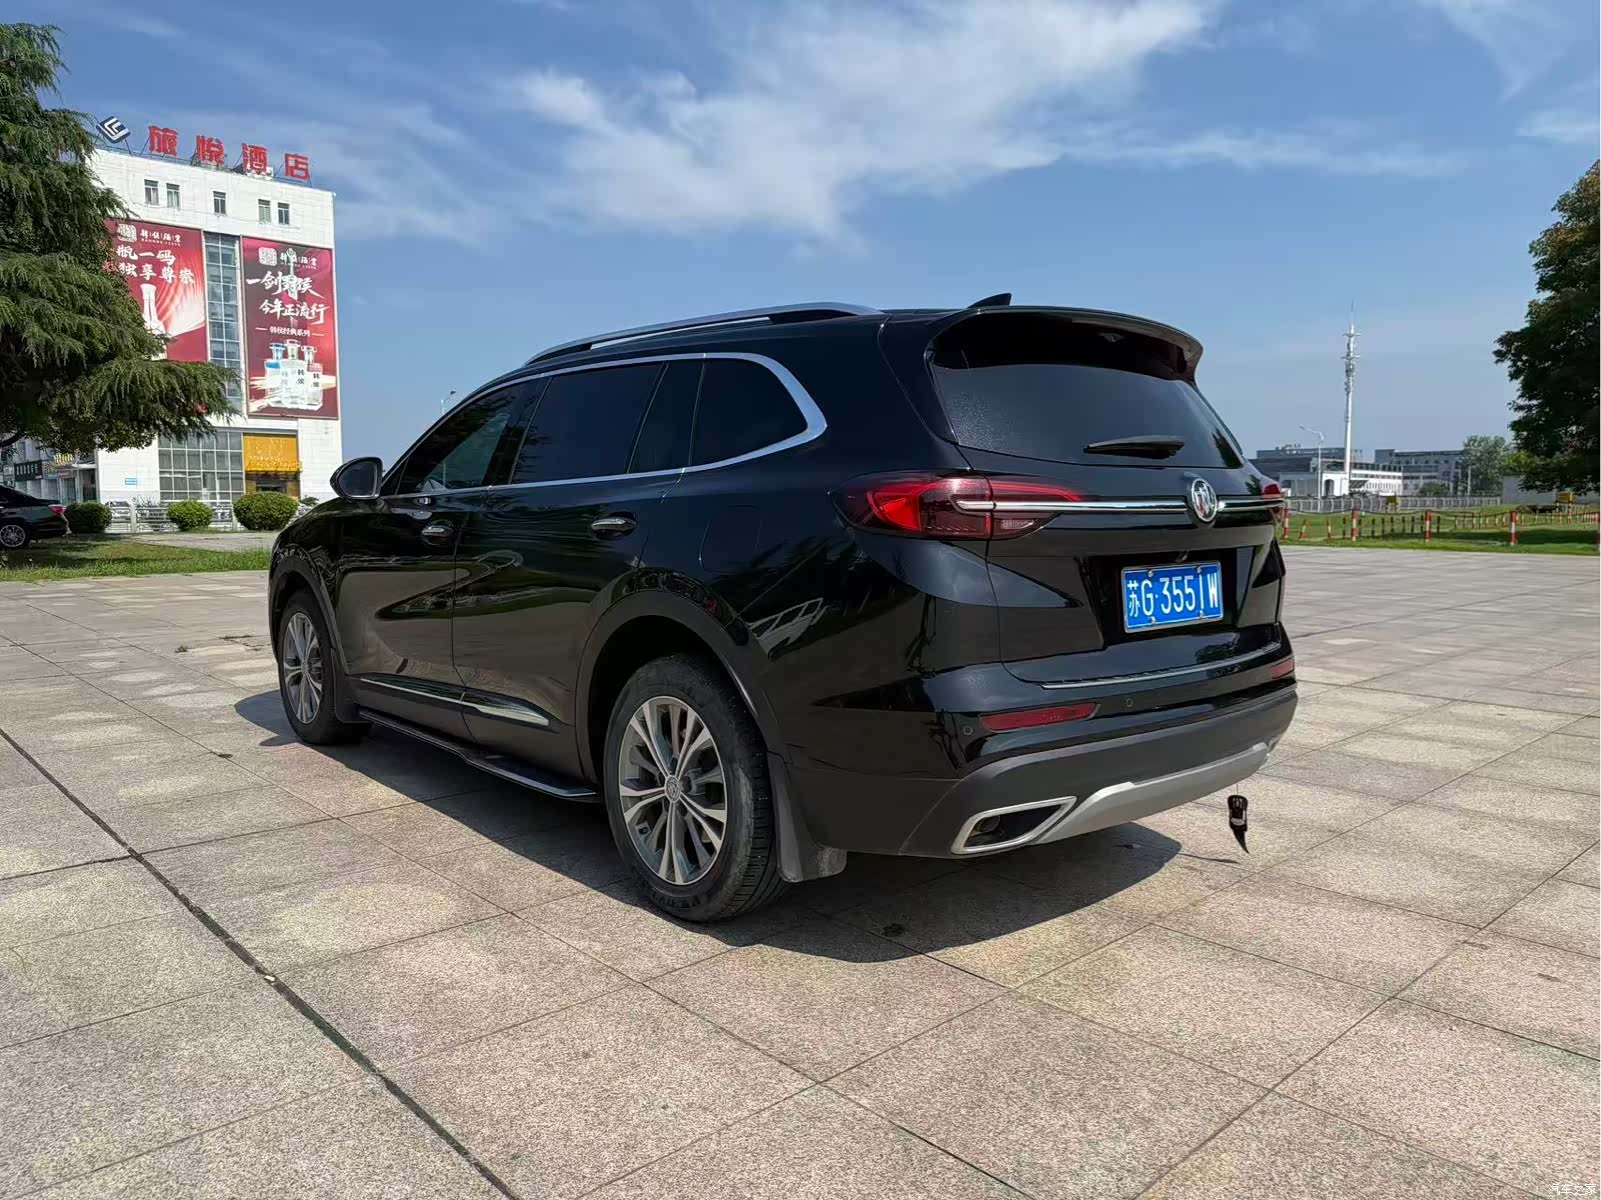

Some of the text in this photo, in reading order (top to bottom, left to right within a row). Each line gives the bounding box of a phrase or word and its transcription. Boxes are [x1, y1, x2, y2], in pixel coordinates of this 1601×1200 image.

[148, 125, 310, 181] 旅悦酒店
[259, 298, 330, 325] 今年正流行
